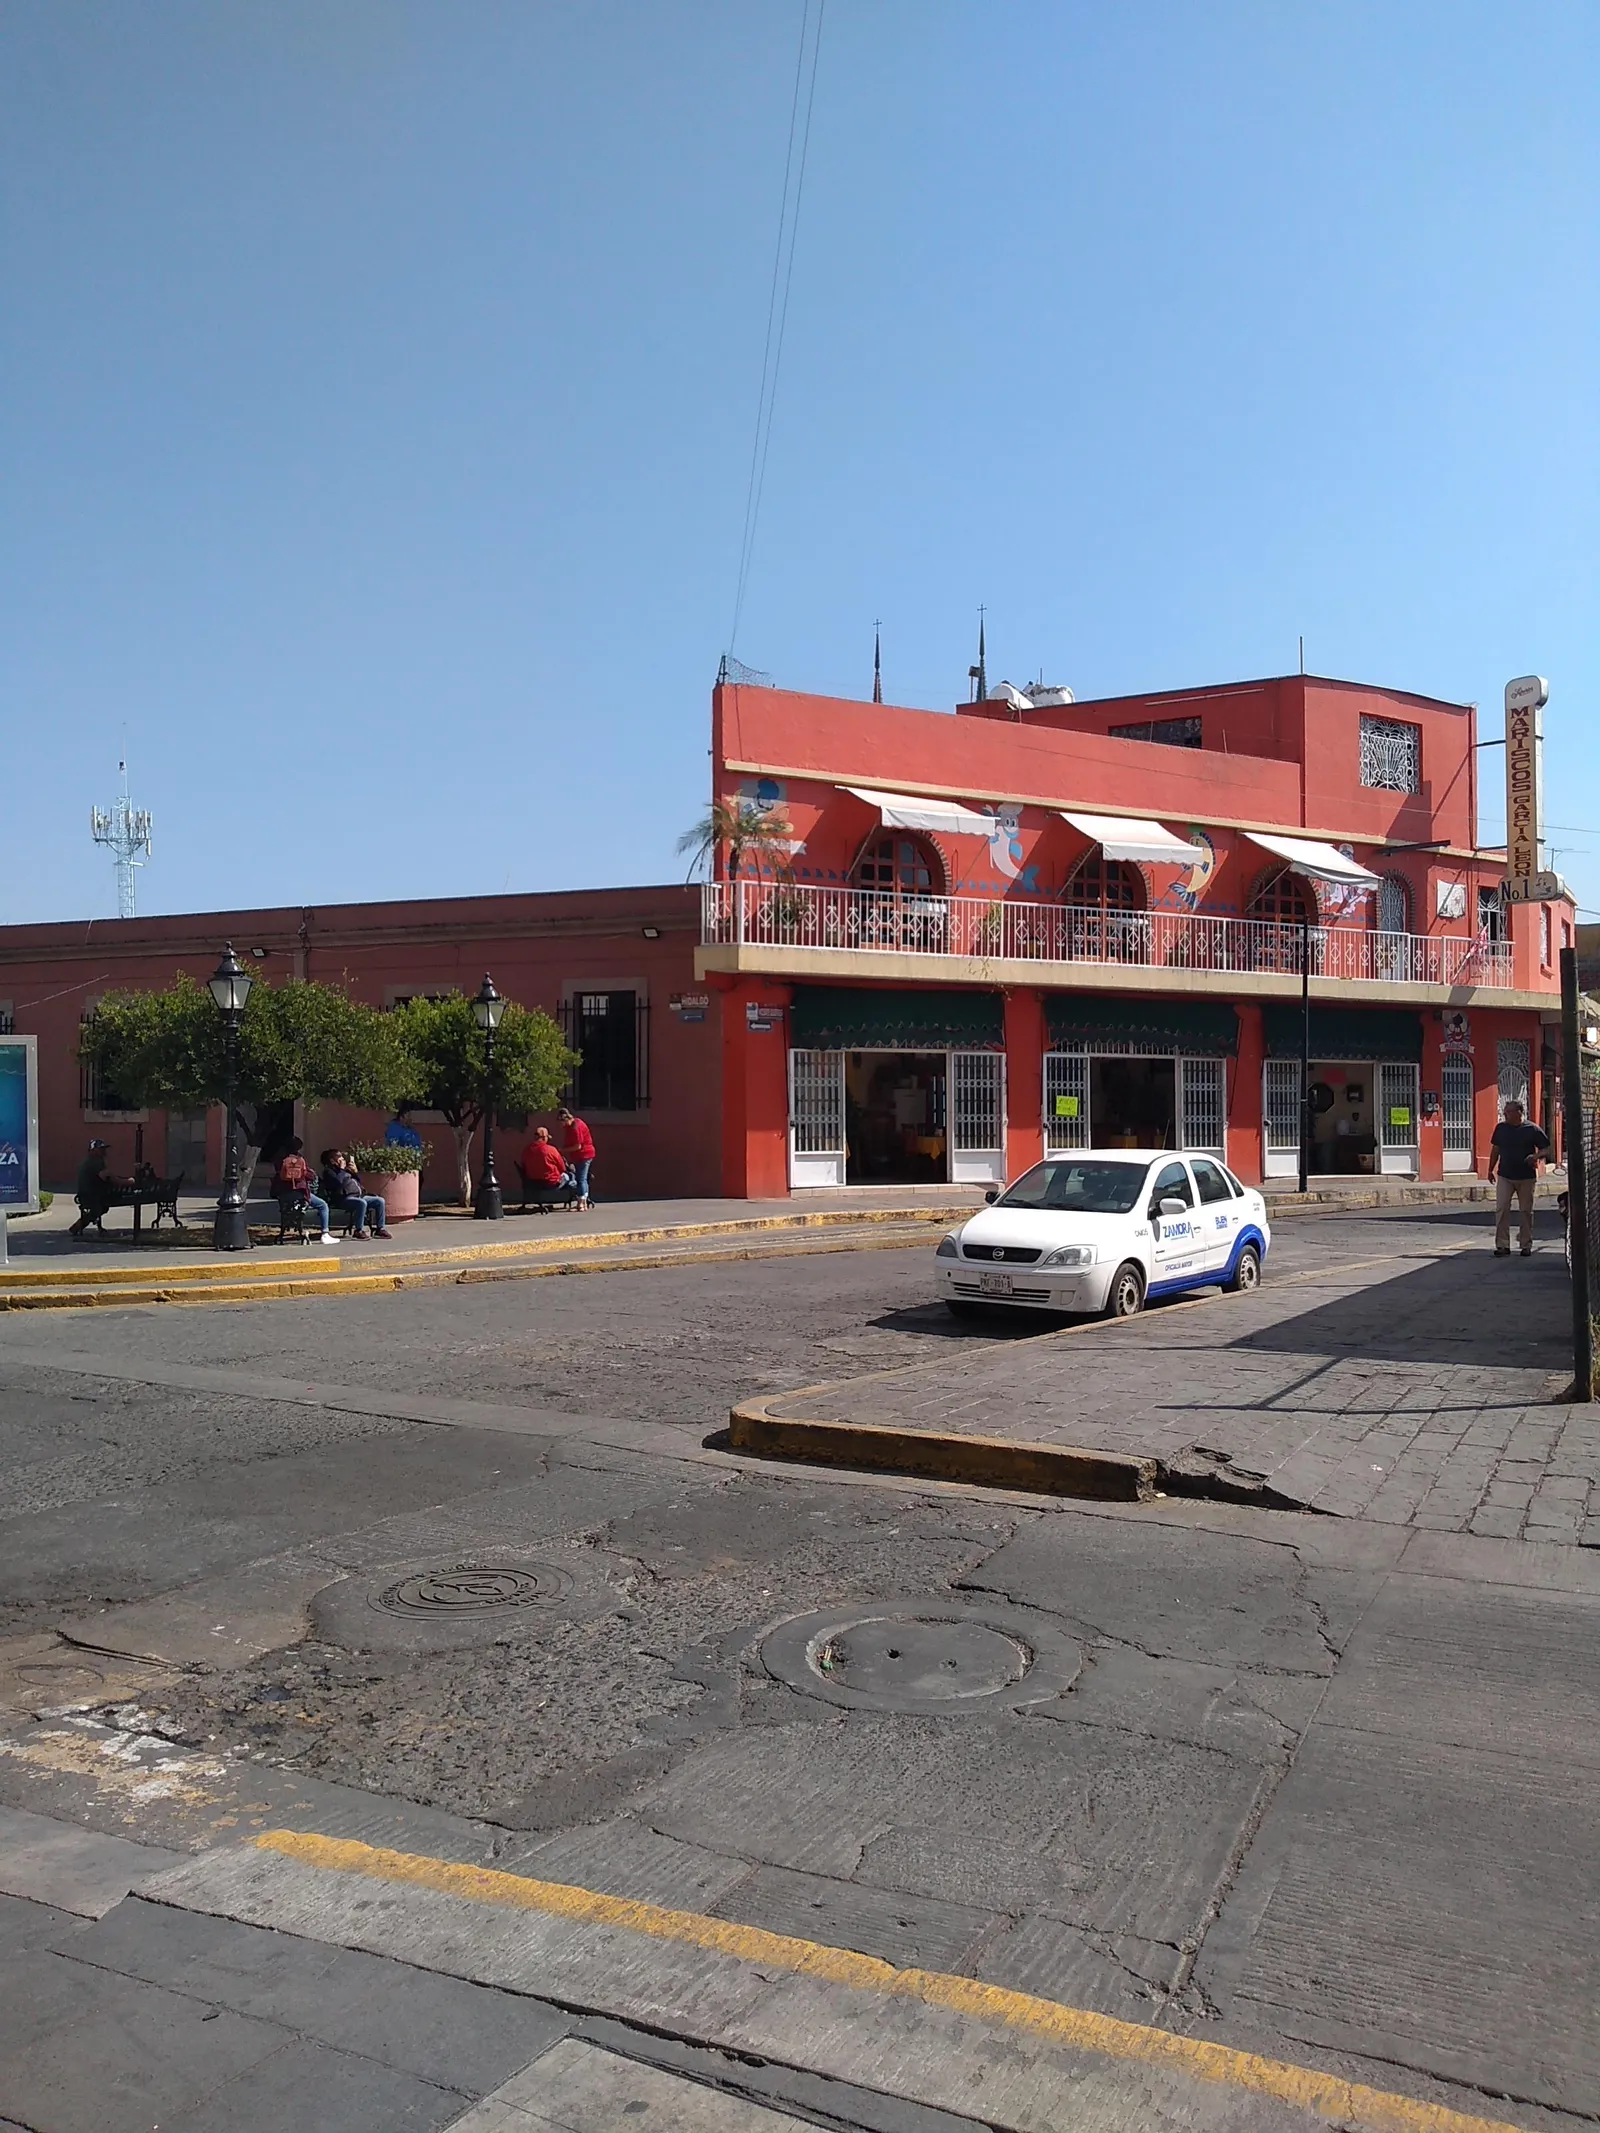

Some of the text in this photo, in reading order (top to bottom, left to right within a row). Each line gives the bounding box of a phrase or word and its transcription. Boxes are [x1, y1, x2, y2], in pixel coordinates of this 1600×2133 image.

[1511, 705, 1531, 792] MARISCOS
[1513, 795, 1531, 842] GARCIA
[1514, 846, 1531, 877] LEON
[681, 995, 709, 1006] HIDALGO
[1162, 1221, 1194, 1239] ZAMORA
